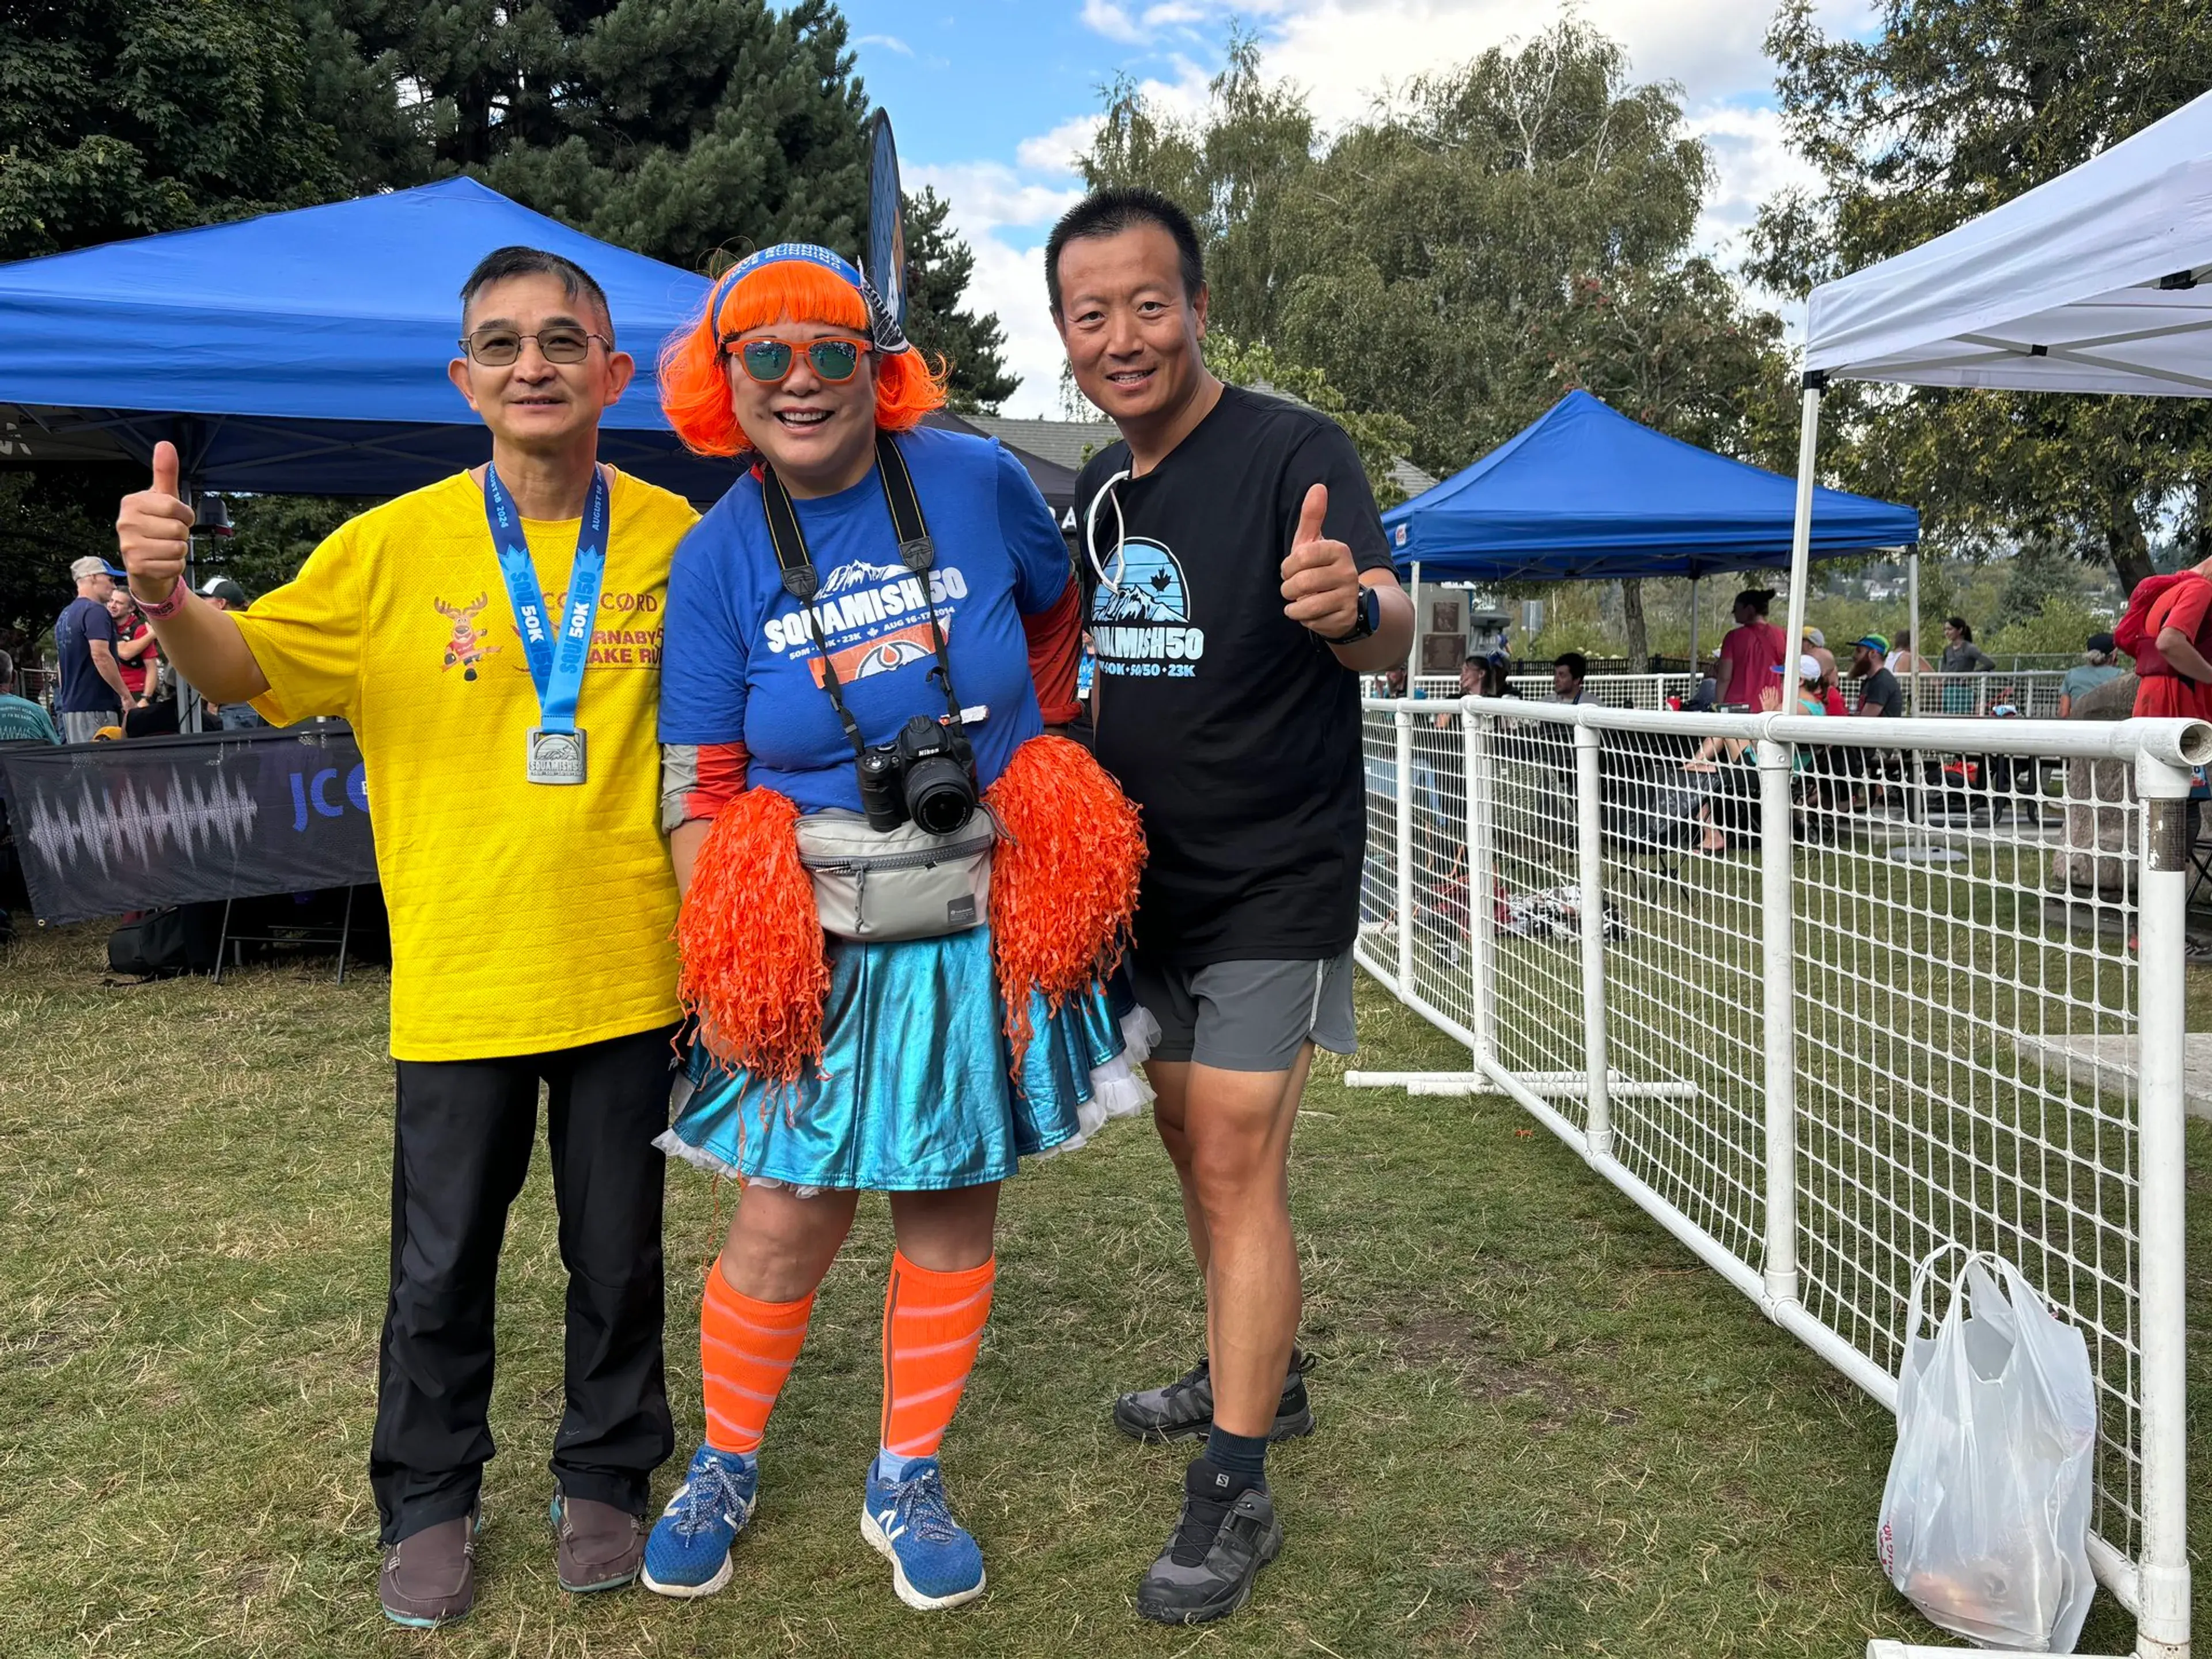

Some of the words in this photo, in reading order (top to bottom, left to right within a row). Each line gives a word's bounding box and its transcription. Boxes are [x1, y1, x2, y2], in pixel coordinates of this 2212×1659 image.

[497, 505, 509, 528] 2024
[592, 494, 602, 531] AUGUST
[542, 592, 658, 612] CCORD
[764, 566, 968, 654] SQUAMISH50
[521, 605, 544, 643] 50K
[569, 601, 590, 639] 50K
[841, 632, 862, 643] 23K
[883, 619, 905, 632] AUG
[934, 606, 956, 617] 2014
[592, 630, 656, 645] RNABY
[589, 648, 632, 663] AKE
[1167, 664, 1196, 677] 23K
[918, 748, 940, 757] Nikon
